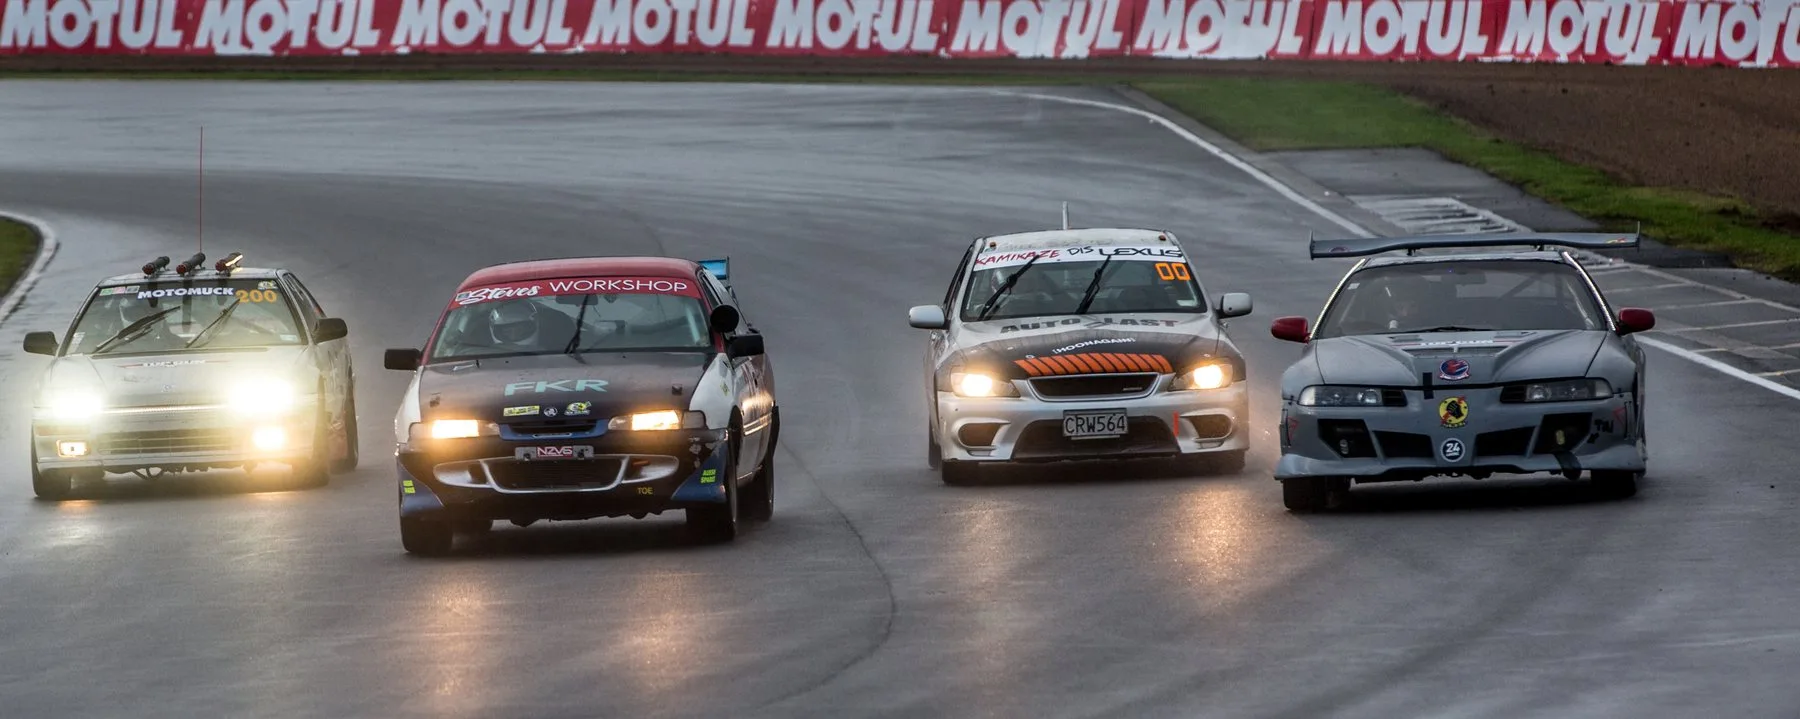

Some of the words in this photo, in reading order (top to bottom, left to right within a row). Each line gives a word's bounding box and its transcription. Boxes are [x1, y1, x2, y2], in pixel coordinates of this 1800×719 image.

[0, 0, 184, 48] MOTUL
[195, 0, 380, 48] MOTUL
[391, 0, 573, 47] MOTUL
[583, 0, 753, 46] MOTUL
[766, 0, 938, 50] MOTUL
[950, 0, 1122, 54] MOTUL
[1134, 0, 1302, 55] MOTUL
[1315, 1, 1488, 56] MOTUL
[1500, 1, 1662, 60] MOTUL
[975, 249, 1060, 266] KAMIKAZE
[1067, 245, 1094, 256] DIS
[1099, 247, 1183, 258] LEXUS
[137, 287, 234, 299] MOTOMUCK
[235, 289, 278, 304] 200
[458, 284, 543, 306] Steves
[549, 279, 688, 293] WORKSHOP
[1000, 317, 1081, 333] AUTO
[504, 379, 609, 396] FKR
[1065, 415, 1125, 433] CRW564
[537, 446, 573, 456] NZV6
[1446, 442, 1460, 452] 24
